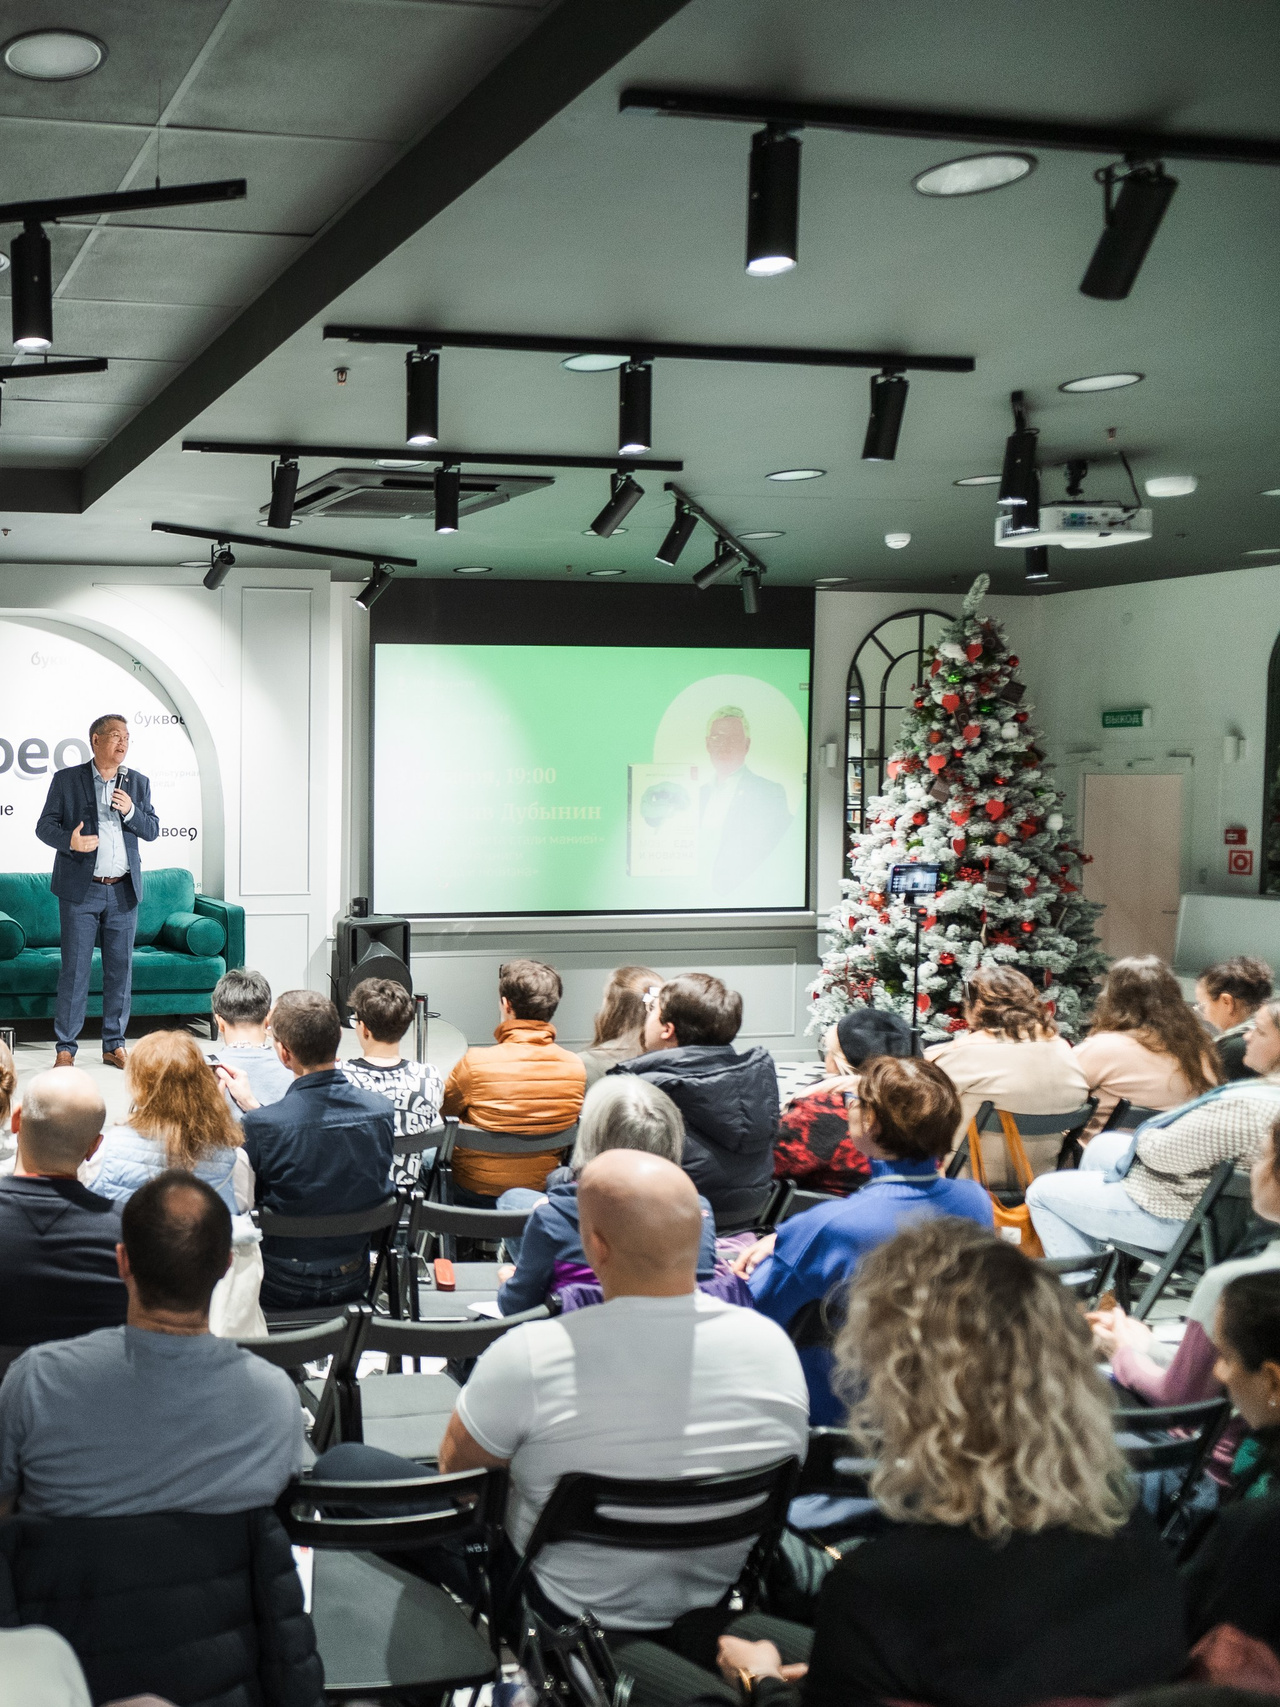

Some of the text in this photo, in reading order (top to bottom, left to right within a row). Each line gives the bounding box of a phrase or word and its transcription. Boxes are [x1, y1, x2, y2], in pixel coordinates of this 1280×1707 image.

[1105, 714, 1141, 725] ВЫХОД
[506, 767, 557, 785] 19:00
[500, 802, 602, 825] Дубынин
[158, 827, 198, 841] воед
